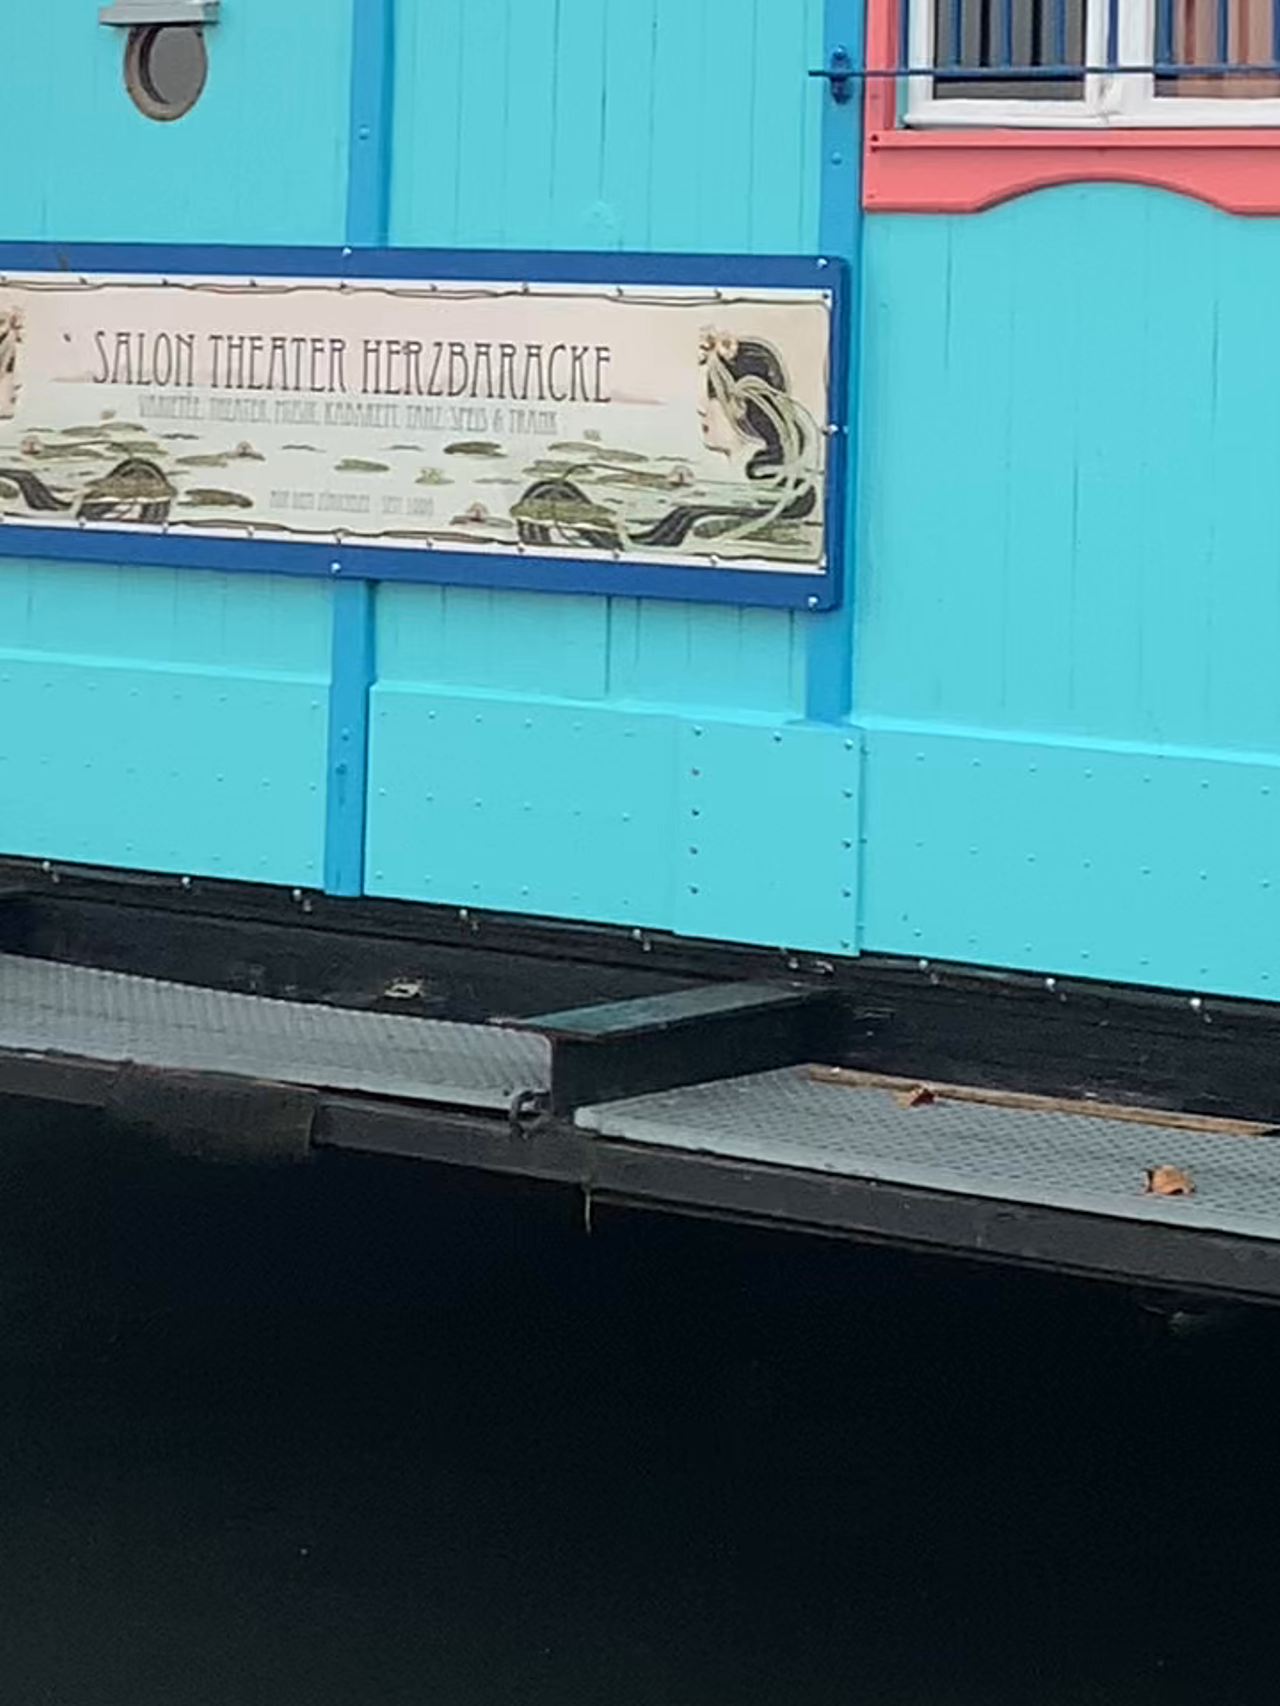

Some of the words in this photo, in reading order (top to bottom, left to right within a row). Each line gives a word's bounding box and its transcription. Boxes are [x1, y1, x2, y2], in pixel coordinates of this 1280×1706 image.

[93, 331, 195, 387] SALON
[208, 334, 347, 393] THEATER
[362, 339, 612, 404] HERZBARACKE
[493, 409, 503, 434] &
